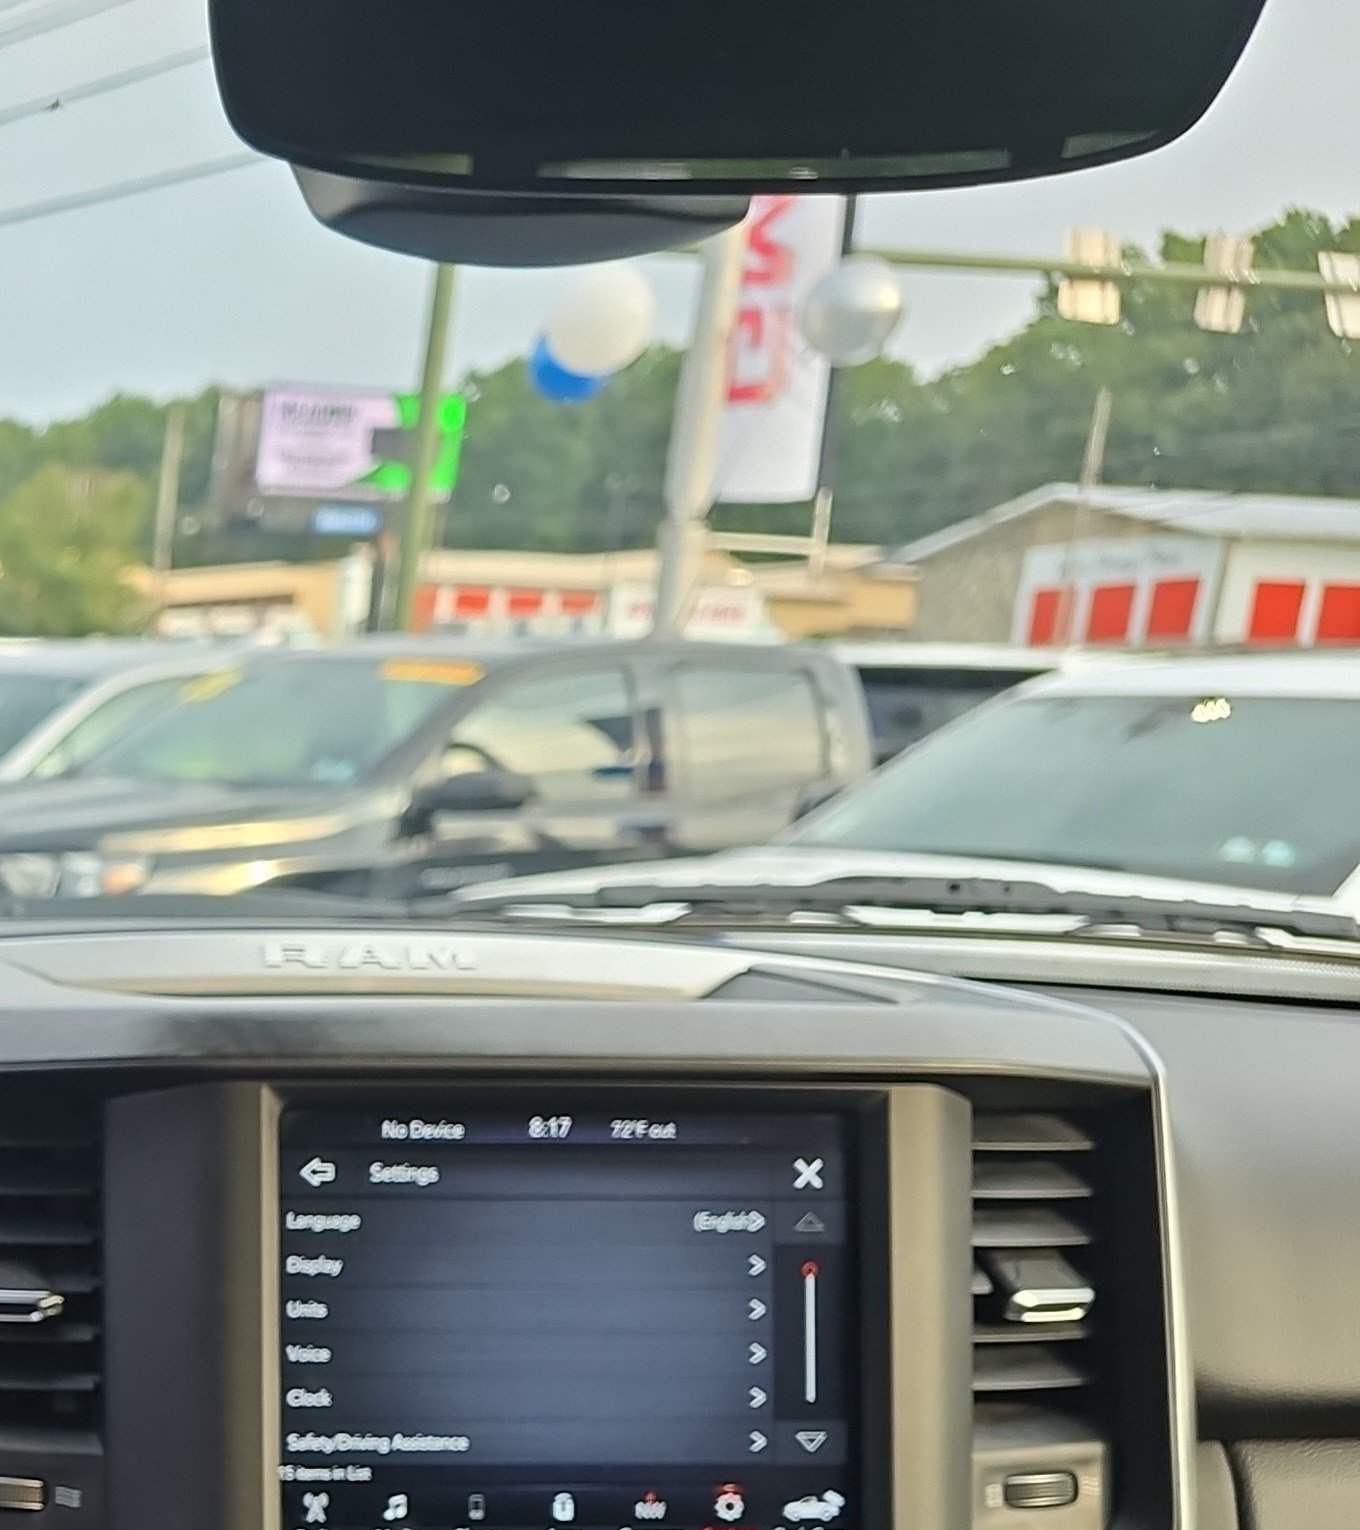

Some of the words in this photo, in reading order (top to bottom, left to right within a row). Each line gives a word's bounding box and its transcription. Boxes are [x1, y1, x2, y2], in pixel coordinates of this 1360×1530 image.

[260, 946, 477, 971] RAM
[381, 1119, 409, 1140] No
[410, 1119, 467, 1141] Device
[528, 1115, 573, 1139] 8:17
[369, 1161, 441, 1187] Settings
[285, 1210, 362, 1233] Language
[285, 1254, 344, 1277] Display
[285, 1299, 329, 1319] Units
[285, 1344, 332, 1363] Voice
[285, 1388, 333, 1407] Clock
[285, 1432, 391, 1455] Safety/Driving
[391, 1432, 471, 1452] Assistance
[346, 1465, 373, 1482] List
